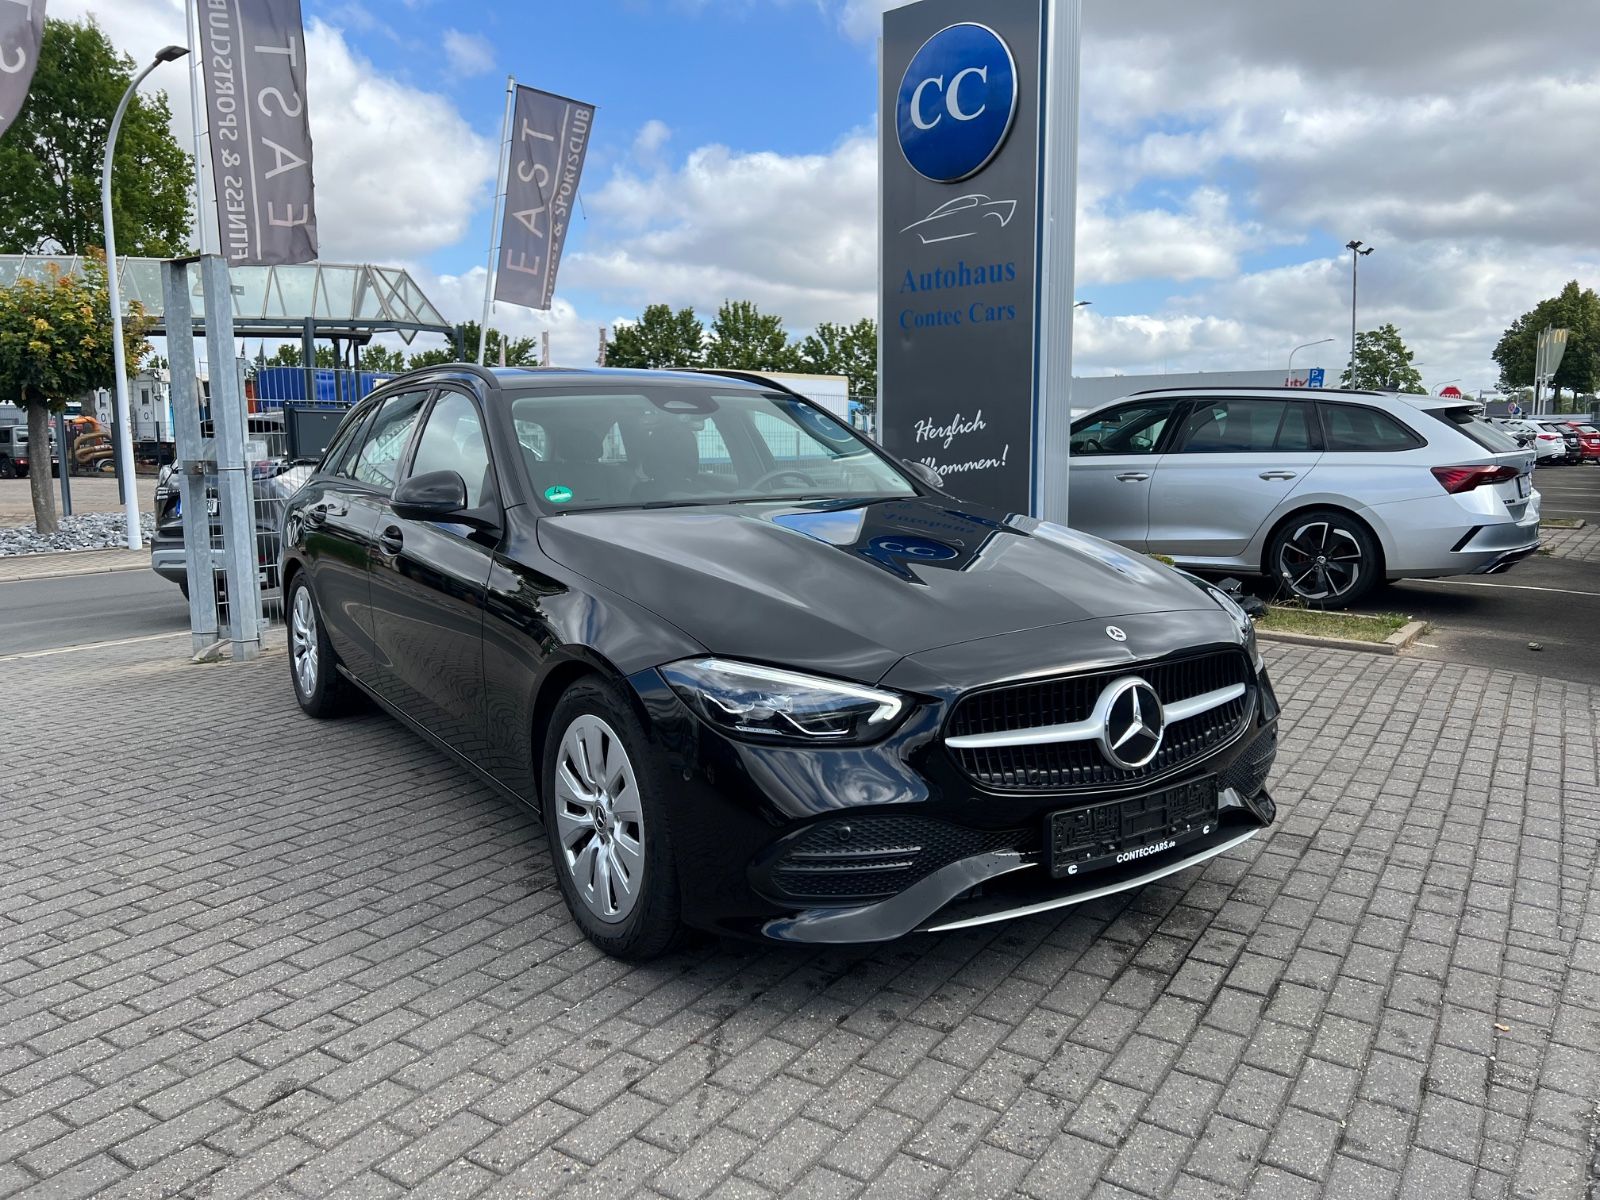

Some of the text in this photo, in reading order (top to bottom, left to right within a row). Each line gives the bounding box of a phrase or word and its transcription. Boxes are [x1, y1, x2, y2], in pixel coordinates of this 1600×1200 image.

[910, 65, 988, 130] CC
[555, 109, 590, 217] SPORTSCLUB
[506, 118, 554, 276] EAST
[900, 260, 1016, 294] Autohaus
[900, 302, 1016, 330] Contec Cars
[914, 409, 986, 449] Herzlich
[1116, 840, 1176, 863] CONTECCARS.de
